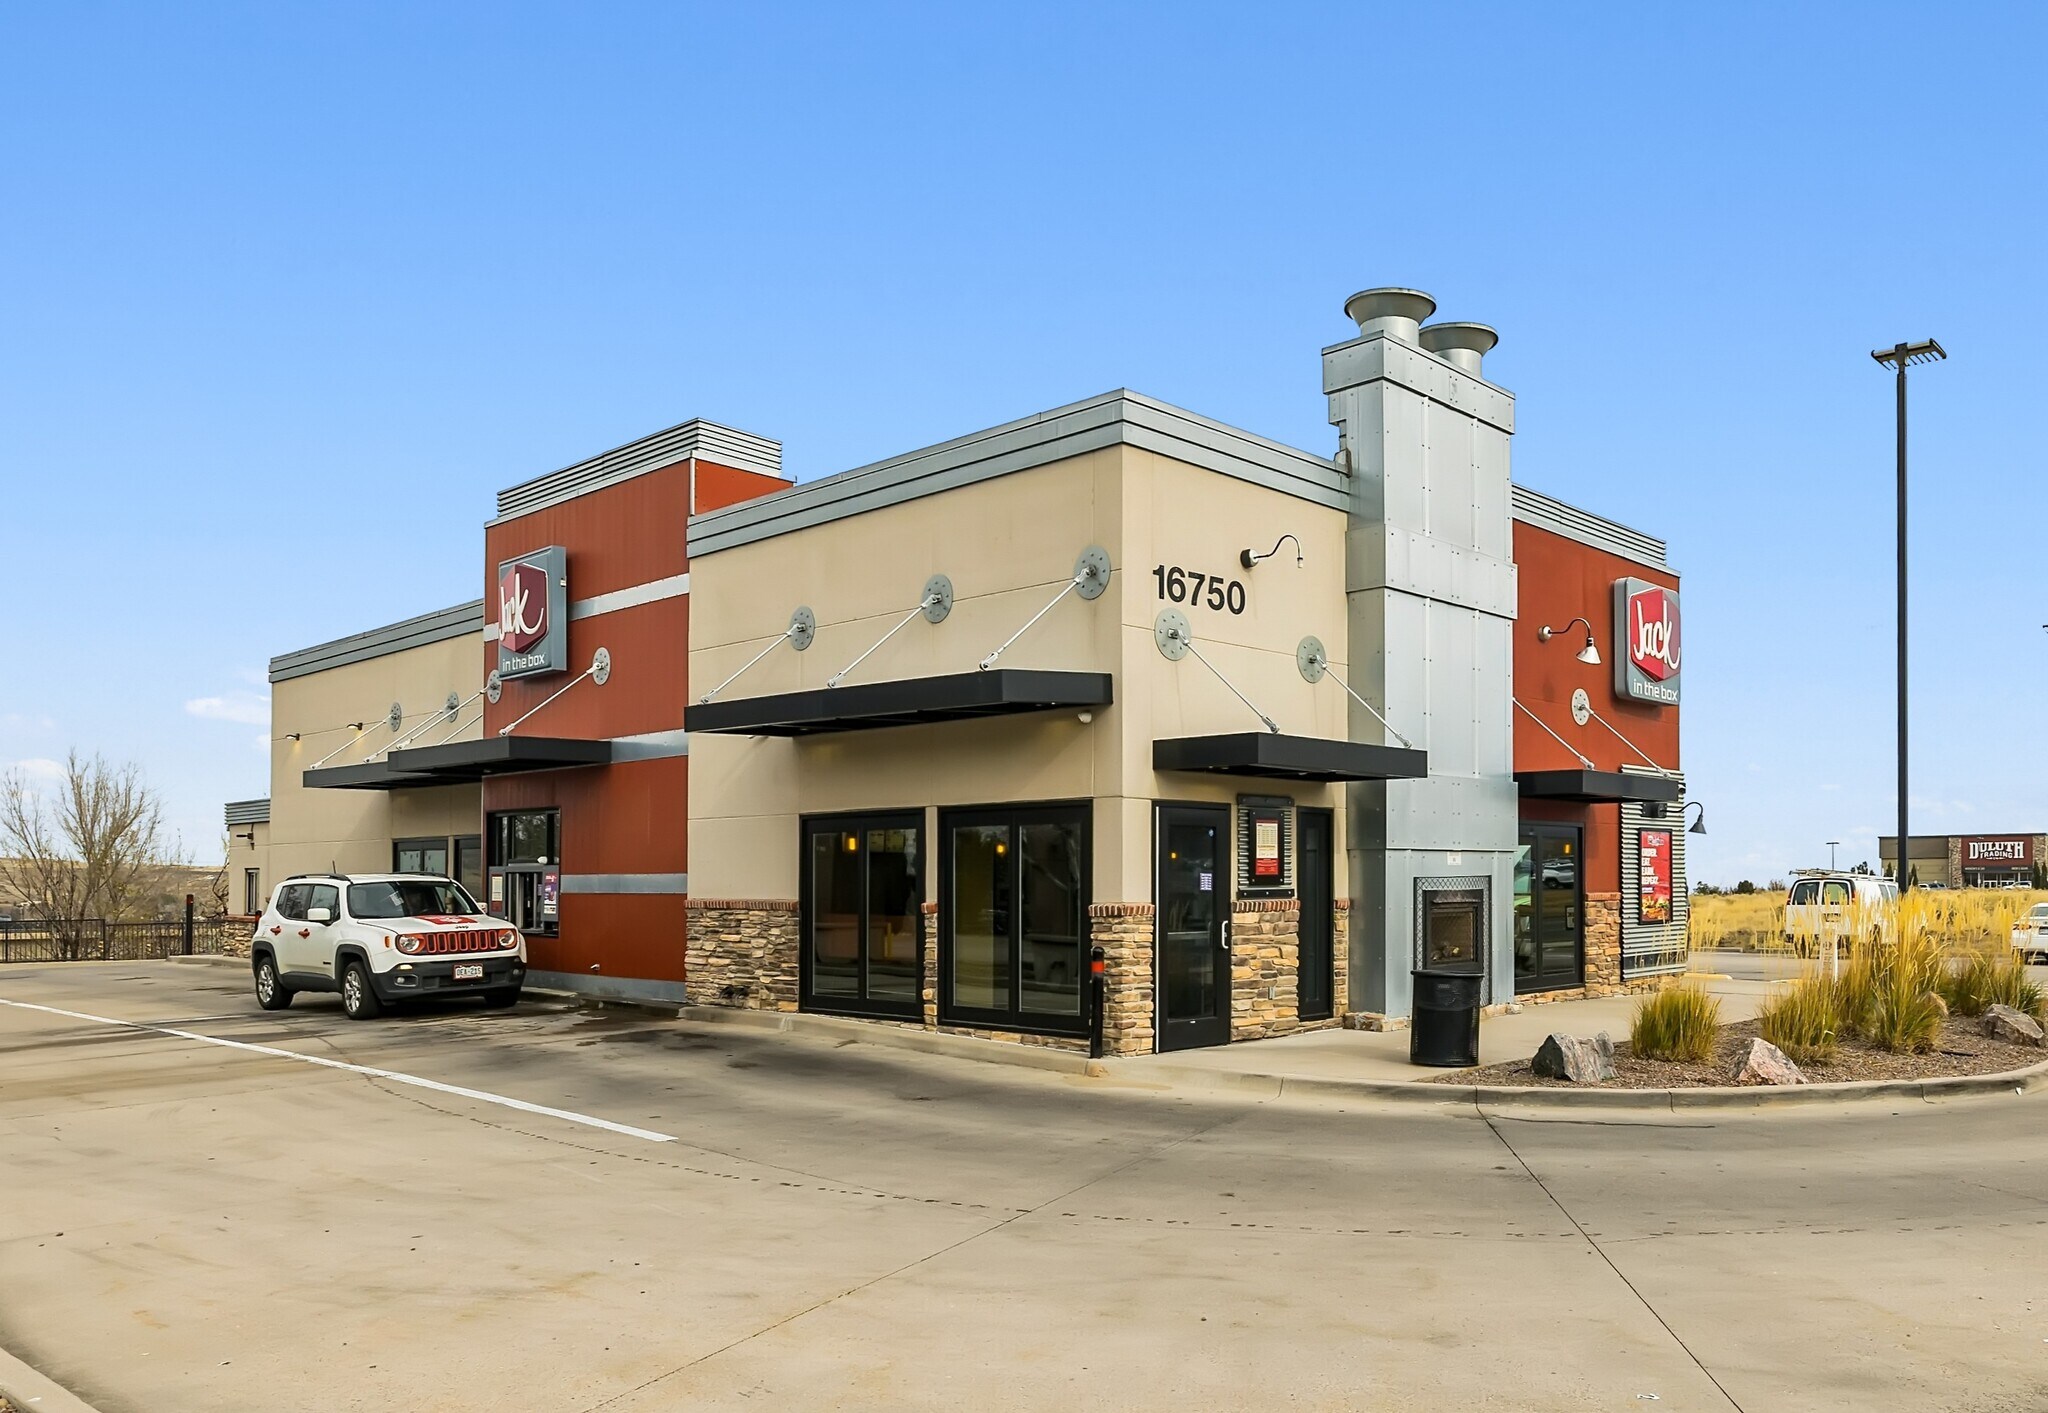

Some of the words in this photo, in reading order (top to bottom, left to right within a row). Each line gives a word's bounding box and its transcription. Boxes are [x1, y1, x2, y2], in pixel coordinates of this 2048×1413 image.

[1152, 565, 1246, 615] 16750
[1633, 600, 1680, 669] Jack
[503, 659, 511, 672] in
[512, 656, 527, 670] the
[528, 654, 545, 667] box
[1633, 679, 1642, 693] in
[1644, 682, 1660, 698] the
[1661, 685, 1678, 701] box
[1968, 841, 2025, 859] DULUTH
[1979, 850, 2013, 859] TRADING
